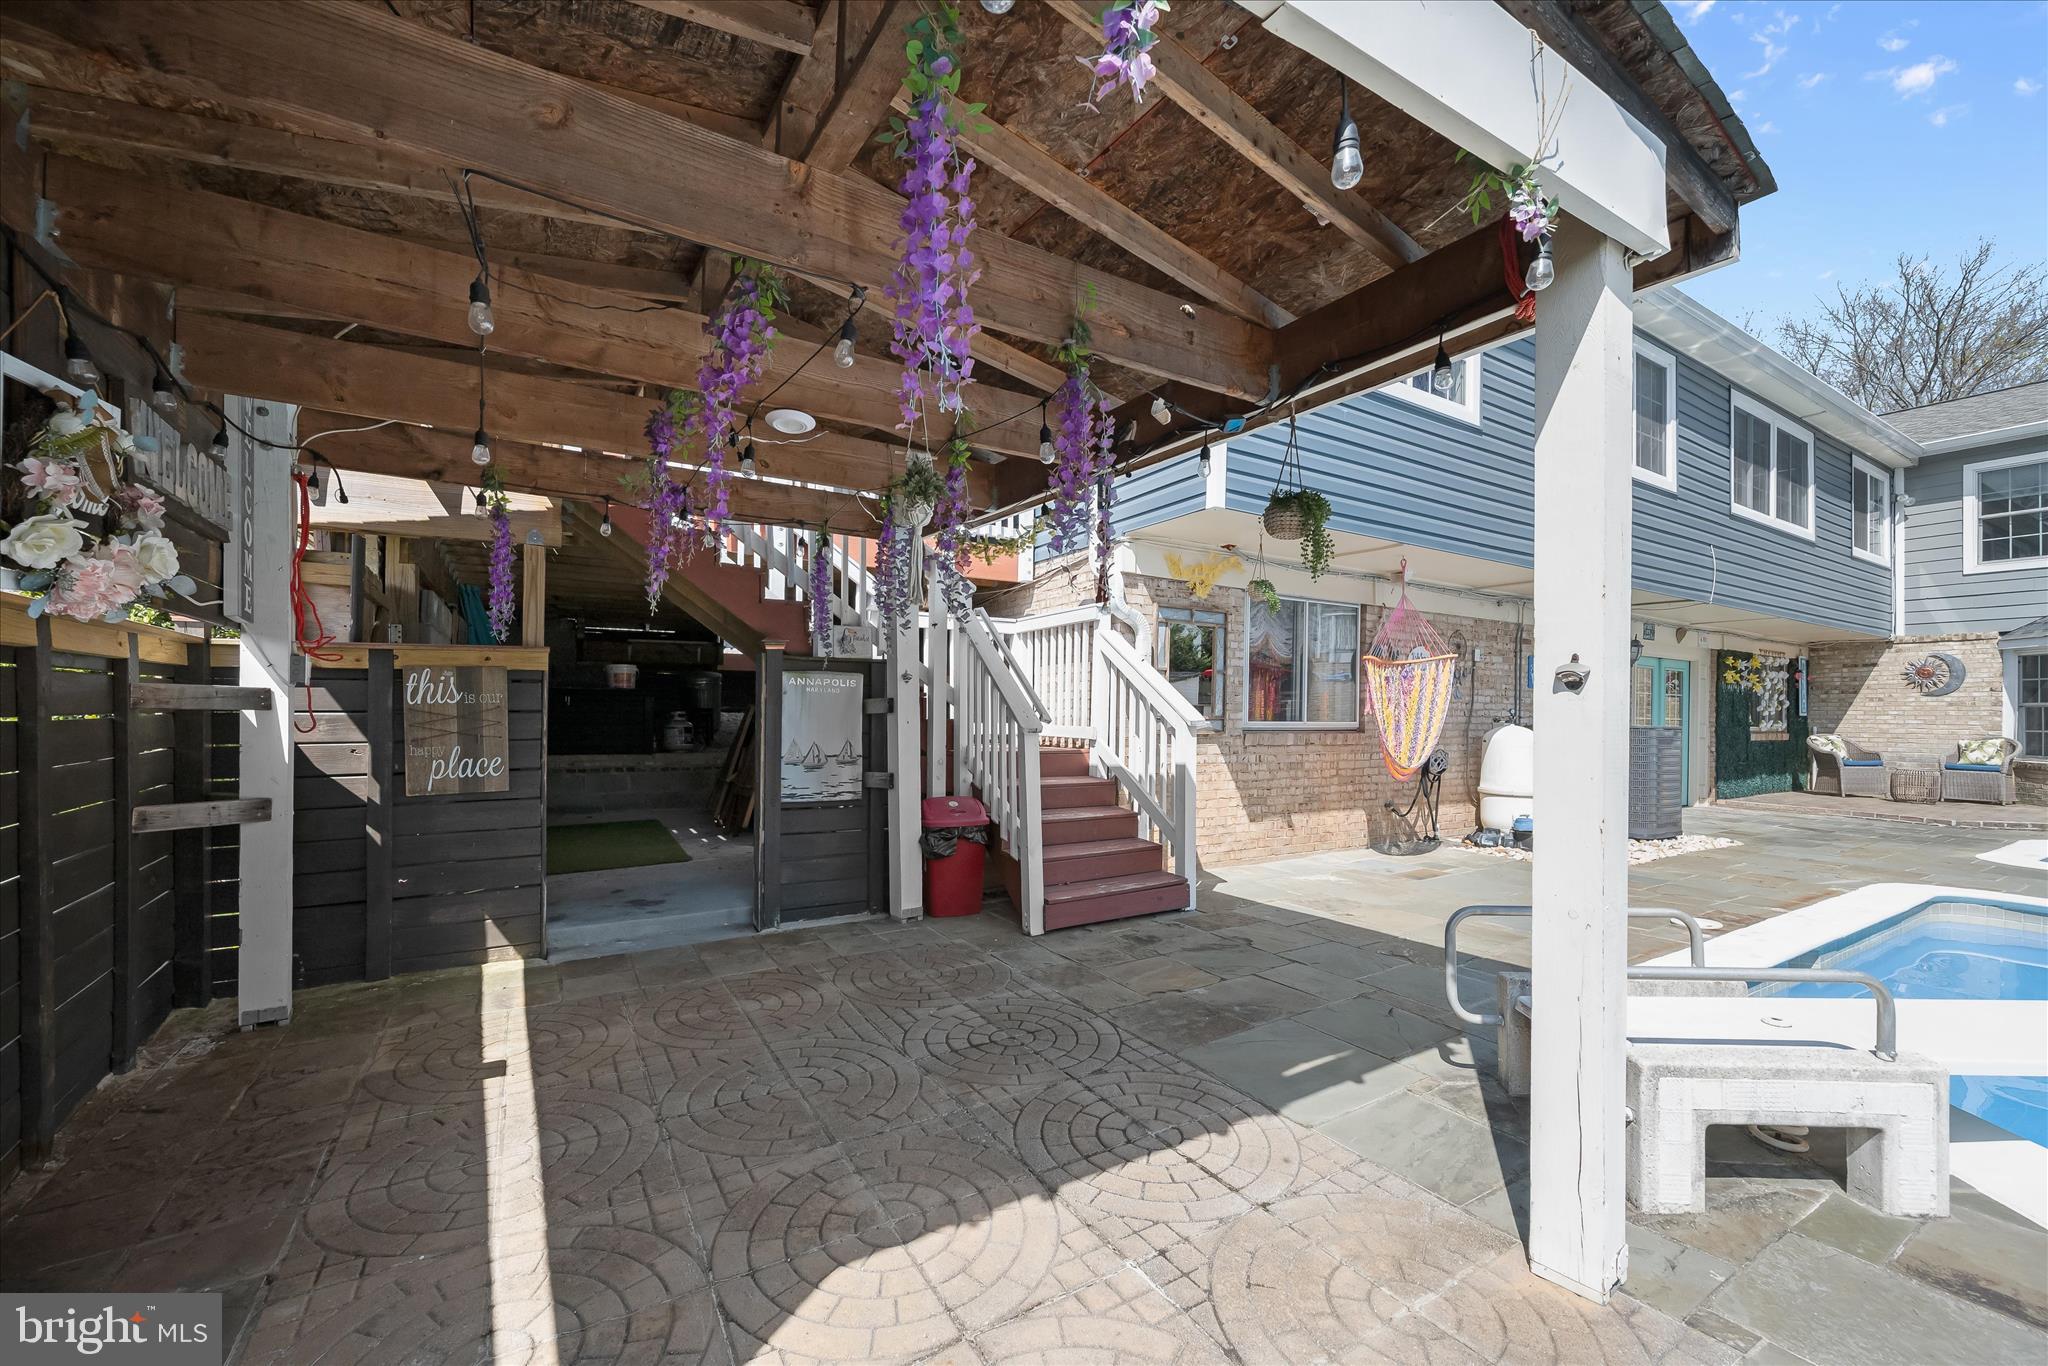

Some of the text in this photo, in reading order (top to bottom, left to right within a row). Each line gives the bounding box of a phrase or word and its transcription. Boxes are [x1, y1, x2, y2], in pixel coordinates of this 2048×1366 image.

[406, 668, 504, 705] this is our
[788, 677, 857, 688] ANNAPOLIS
[409, 744, 446, 759] happy
[427, 745, 505, 792] place
